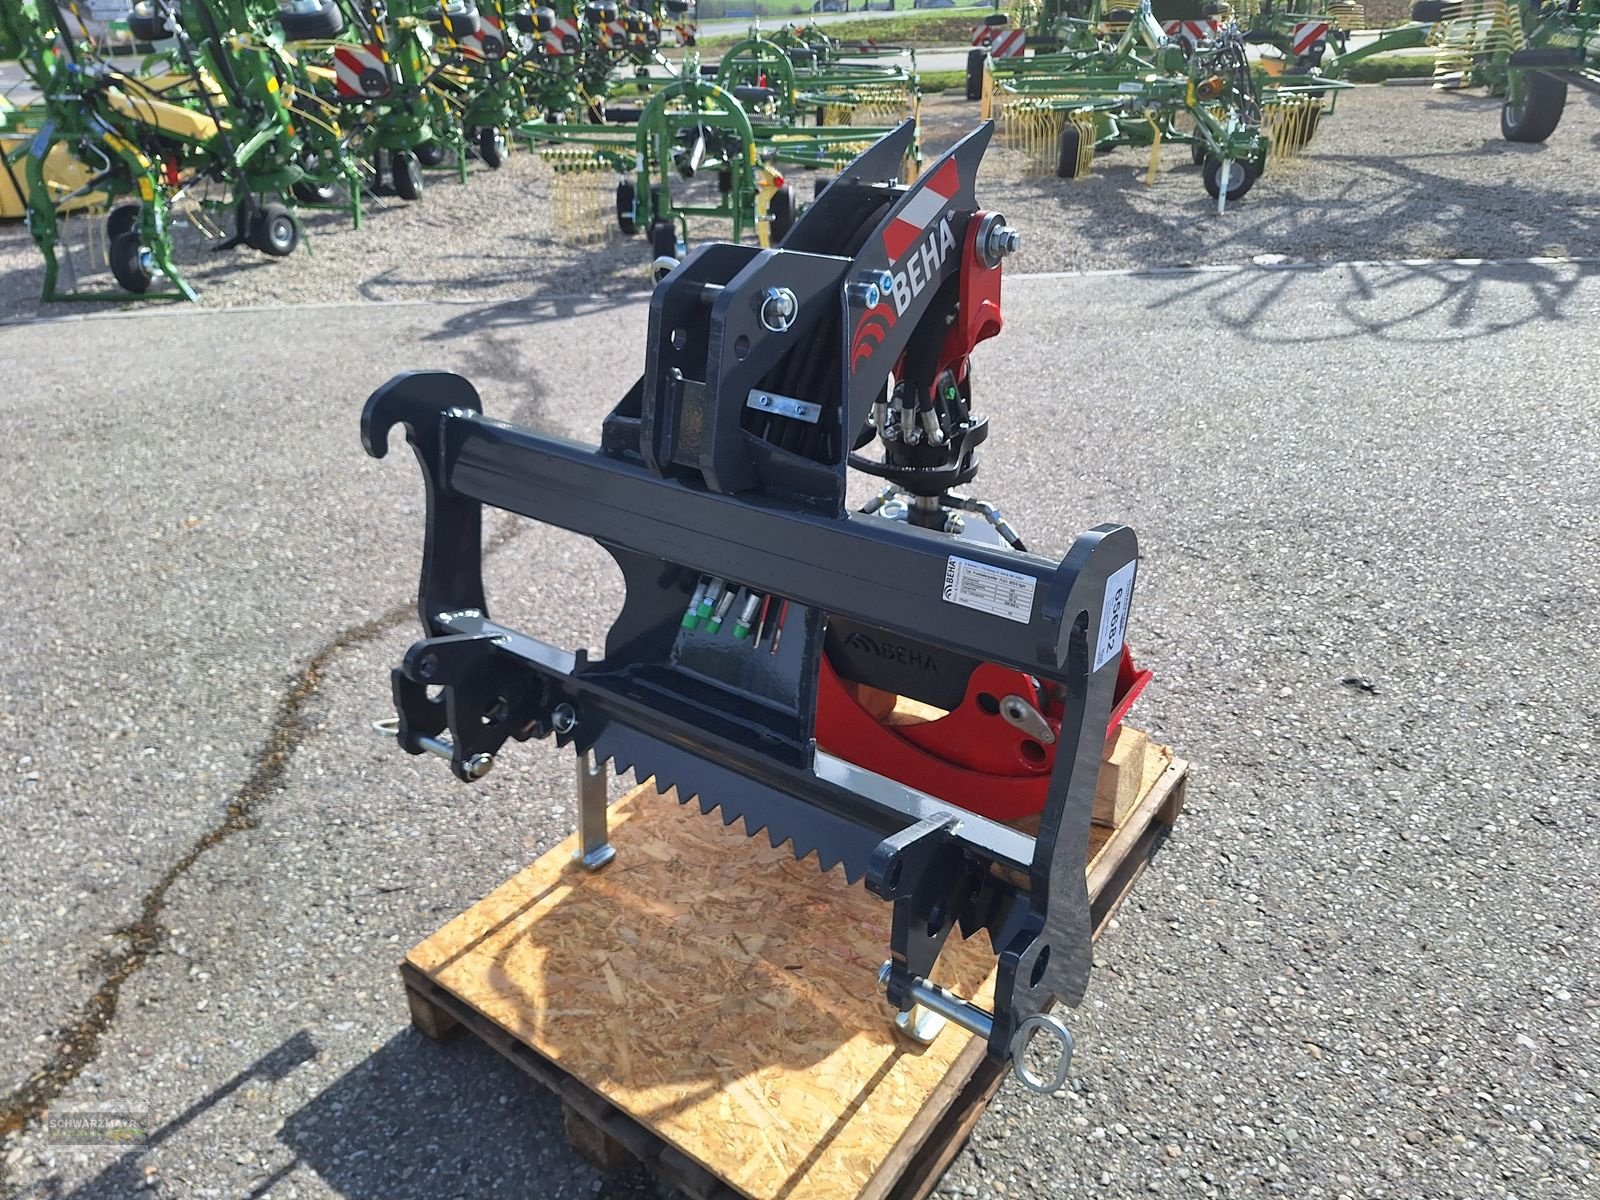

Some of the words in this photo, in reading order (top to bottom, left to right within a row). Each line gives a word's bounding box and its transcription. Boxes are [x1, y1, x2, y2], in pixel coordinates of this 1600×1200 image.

[891, 219, 957, 317] BEHA
[946, 560, 956, 583] BEHA
[1105, 587, 1123, 653] 65682
[882, 641, 939, 674] BEHA
